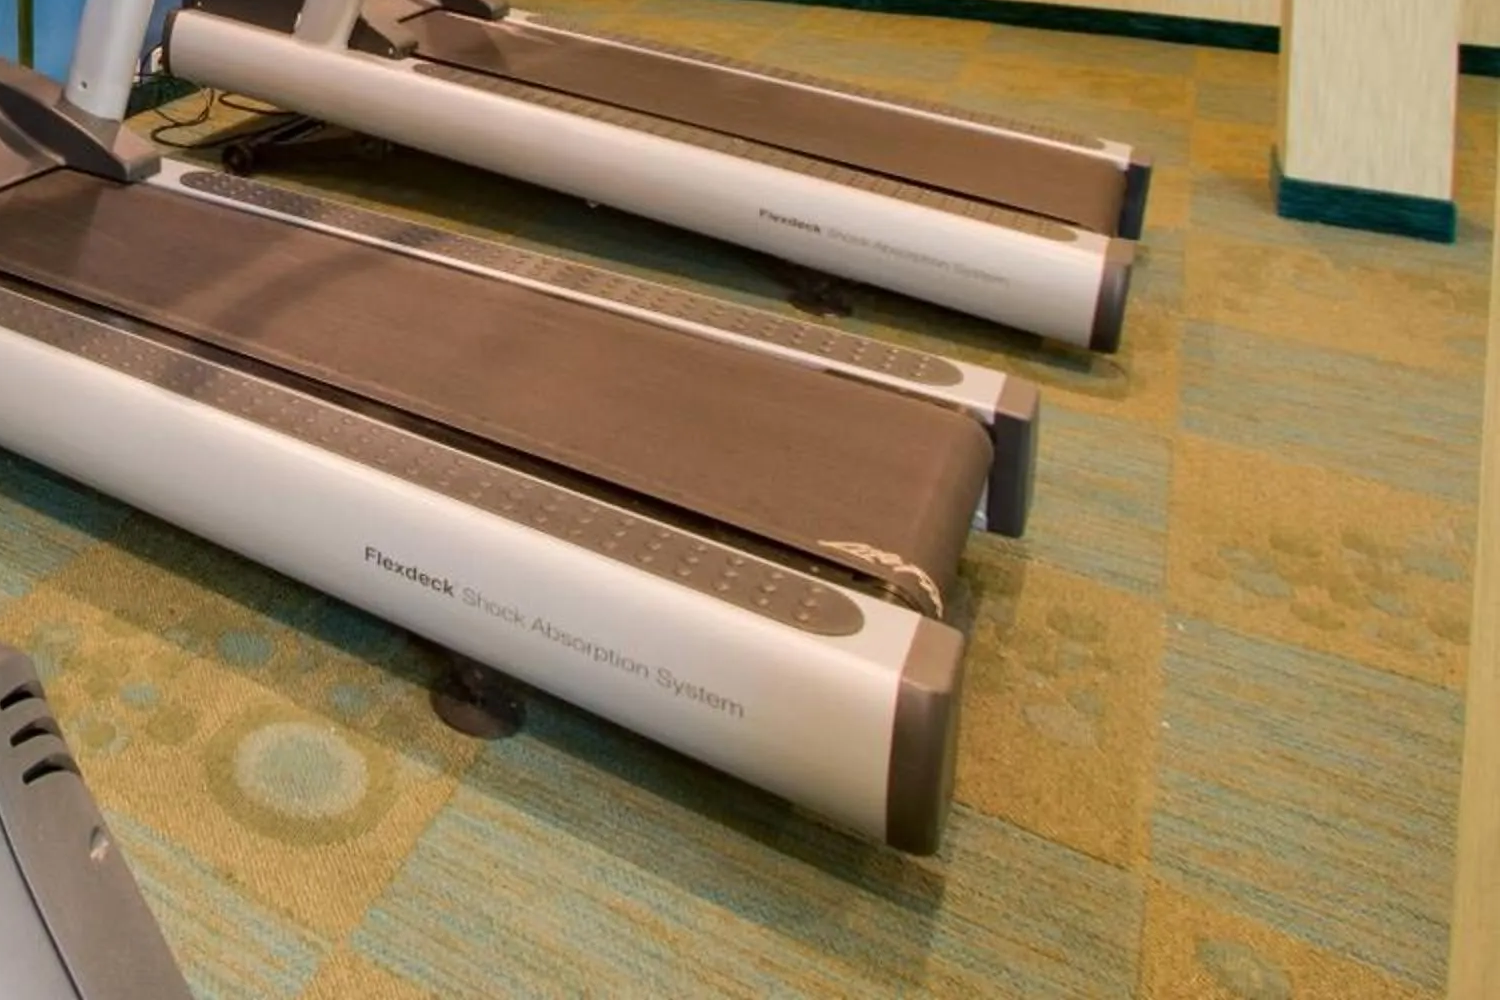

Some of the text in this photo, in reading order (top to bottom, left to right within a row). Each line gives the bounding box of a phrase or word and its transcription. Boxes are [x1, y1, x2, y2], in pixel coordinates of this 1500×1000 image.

[363, 545, 746, 720] Flexdeck Shock Absorption System
